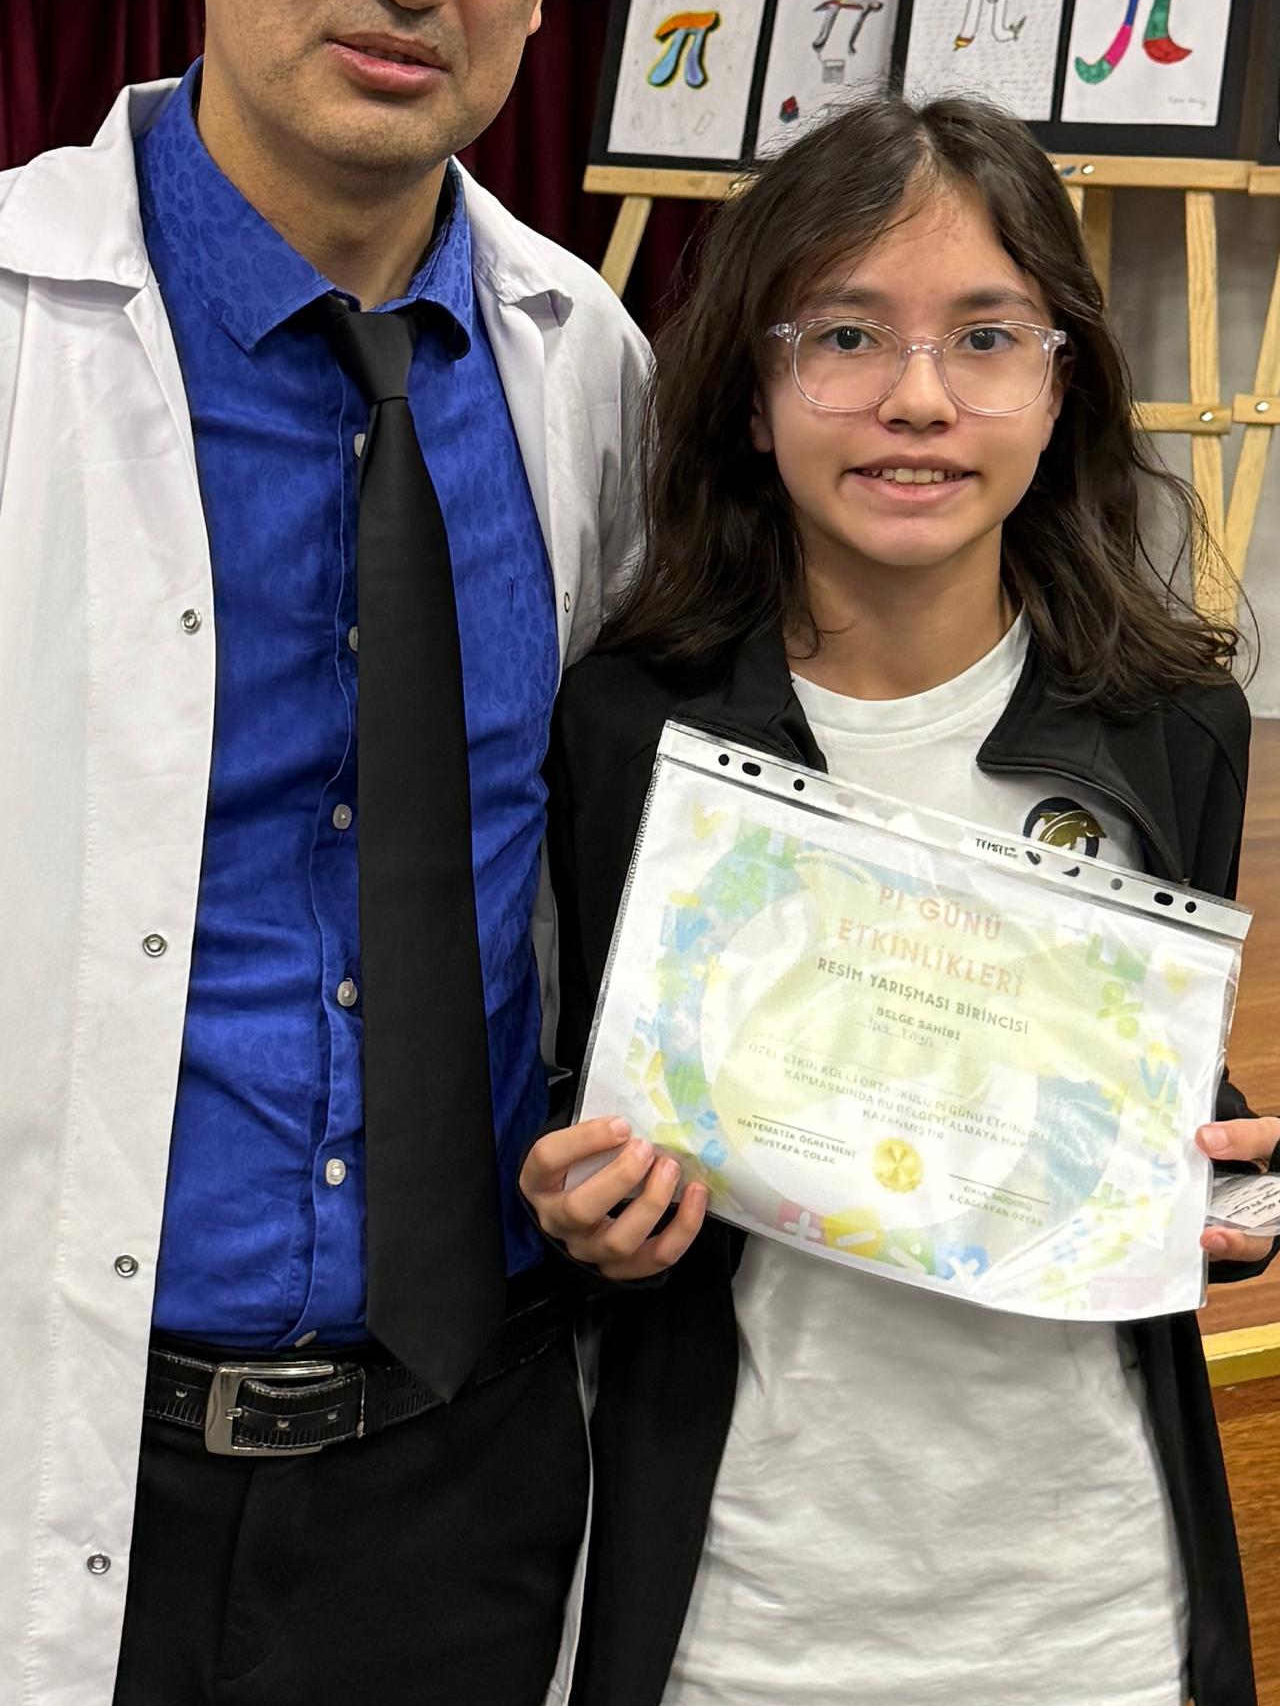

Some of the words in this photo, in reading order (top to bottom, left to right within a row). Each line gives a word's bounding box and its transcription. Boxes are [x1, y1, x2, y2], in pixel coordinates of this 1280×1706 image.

[920, 898, 1003, 941] GÜNÜ
[817, 957, 863, 982] RESİM
[870, 974, 950, 1011] YARIŞMASI
[956, 1001, 1029, 1035] BİRİNCİSİ
[877, 1006, 914, 1026] BELGE
